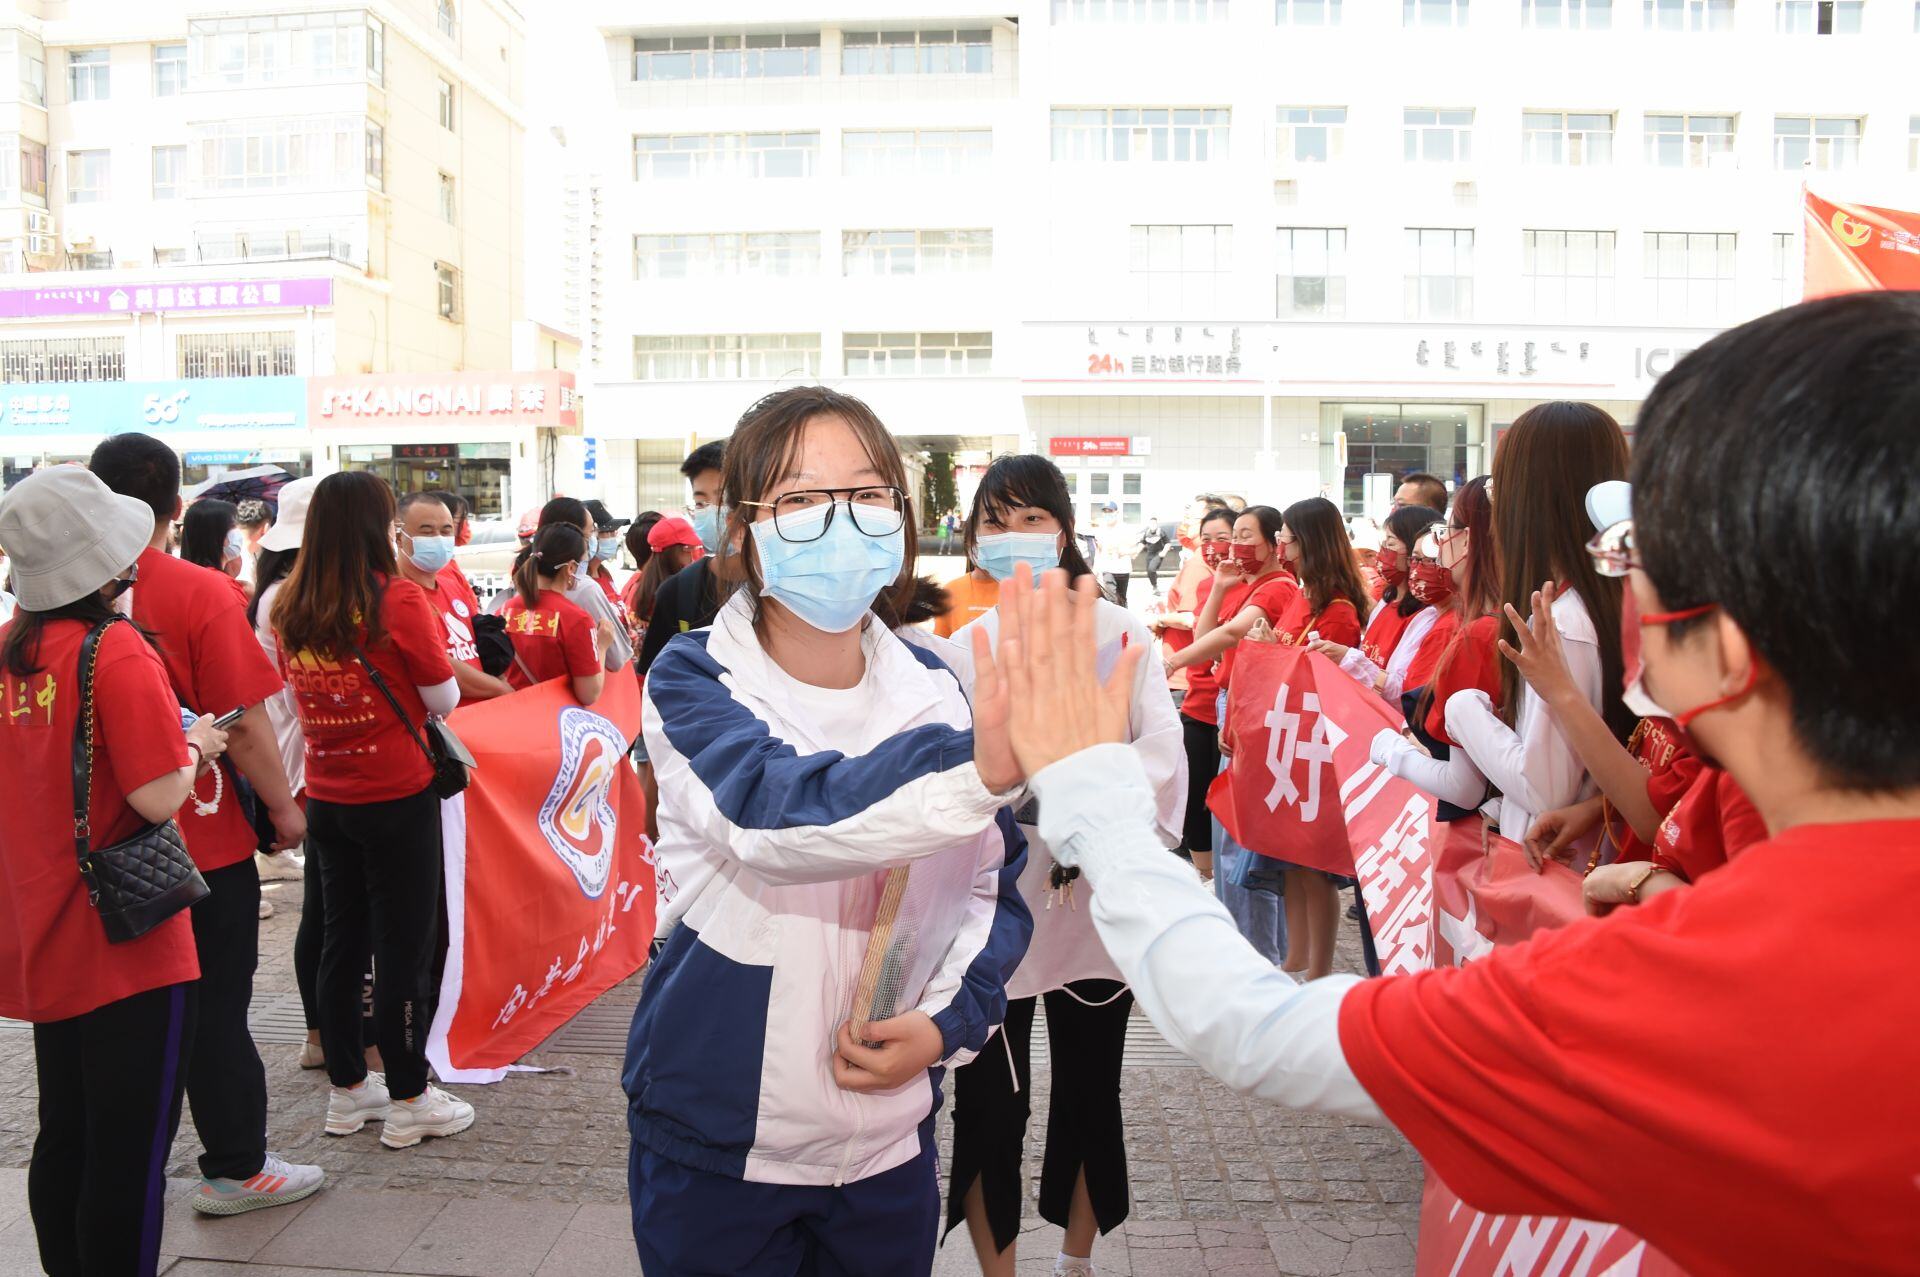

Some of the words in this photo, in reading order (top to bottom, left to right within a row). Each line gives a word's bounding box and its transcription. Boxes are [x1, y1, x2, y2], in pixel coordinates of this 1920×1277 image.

[1088, 353, 1124, 374] 24h
[1131, 354, 1242, 374] 自助银行服务
[1635, 347, 1695, 379] IC
[351, 383, 481, 416] KANGNAI
